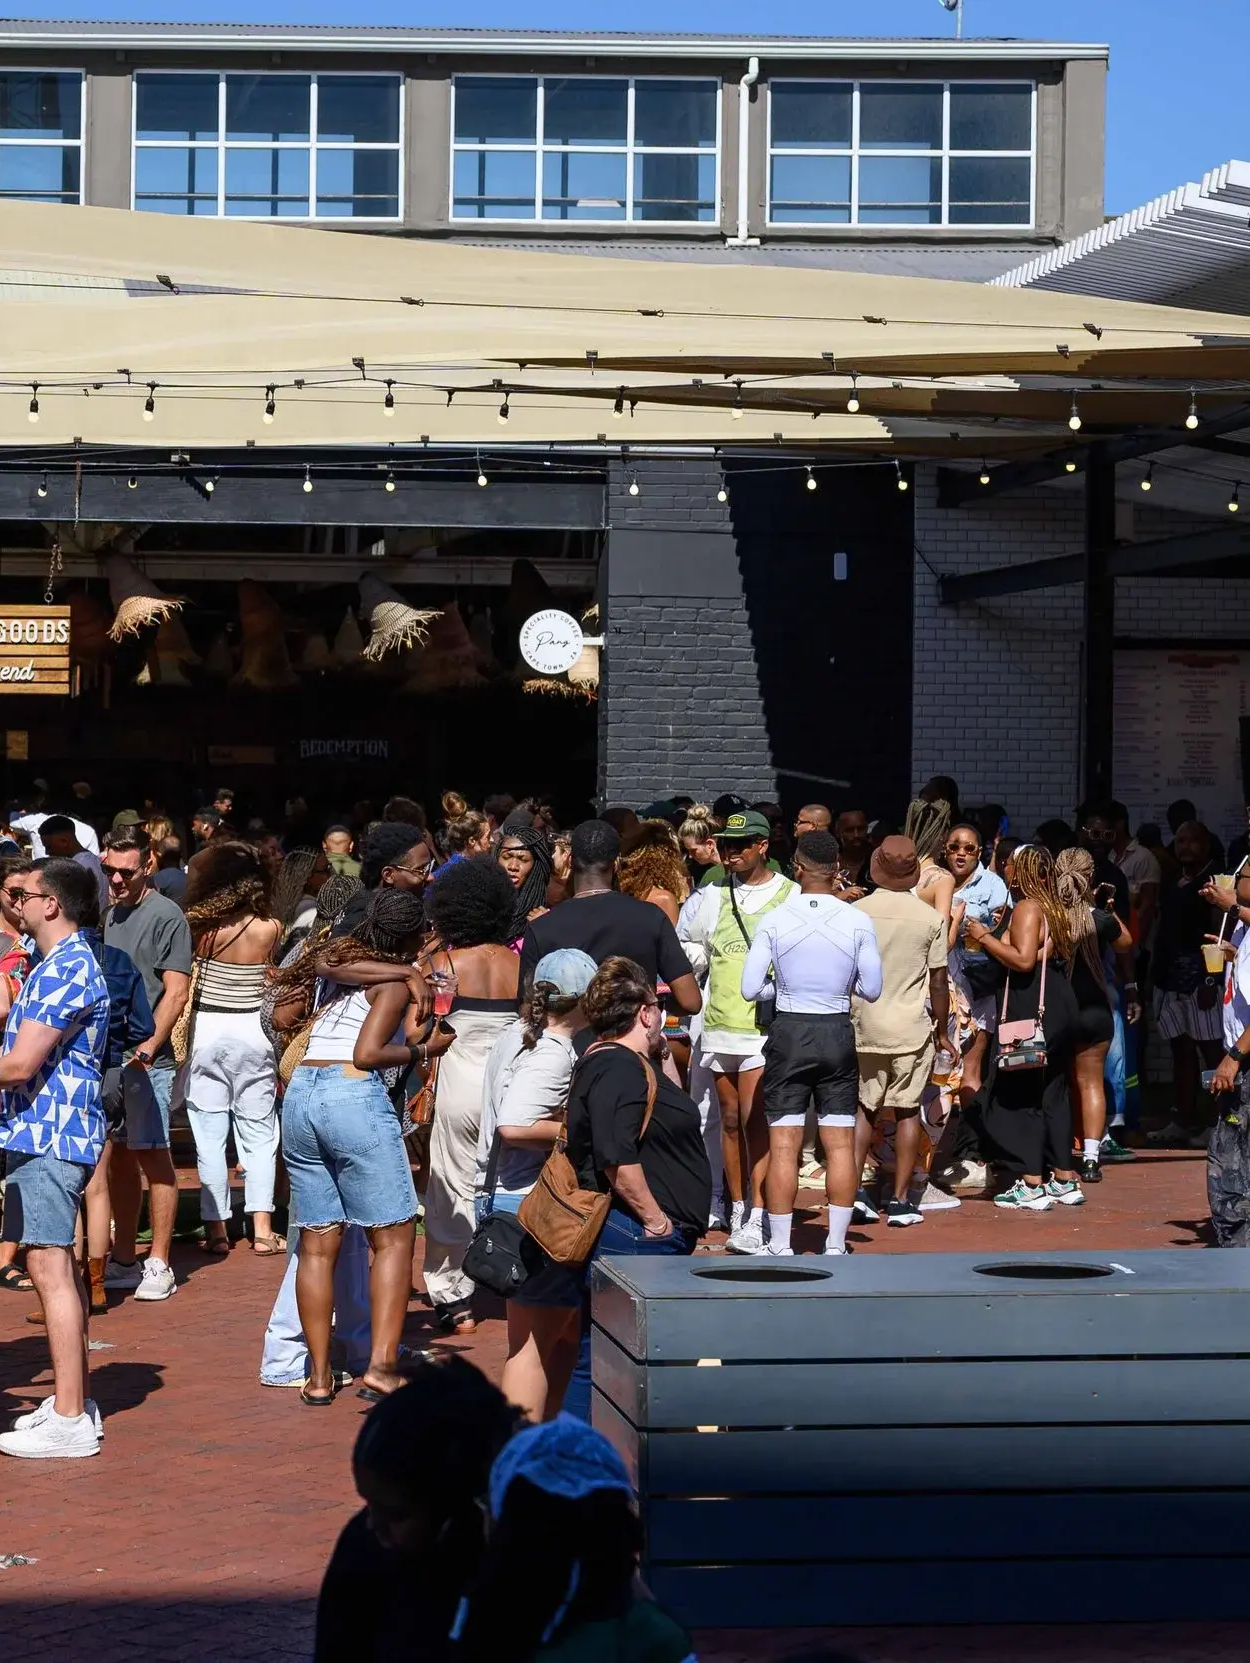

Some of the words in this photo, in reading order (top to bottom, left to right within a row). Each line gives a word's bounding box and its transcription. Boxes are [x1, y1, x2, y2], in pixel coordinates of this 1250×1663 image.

[524, 613, 556, 639] SPECIALITY
[561, 615, 579, 638] COFFEE
[525, 650, 540, 666] CAPE
[299, 738, 391, 760] REDEMPTION
